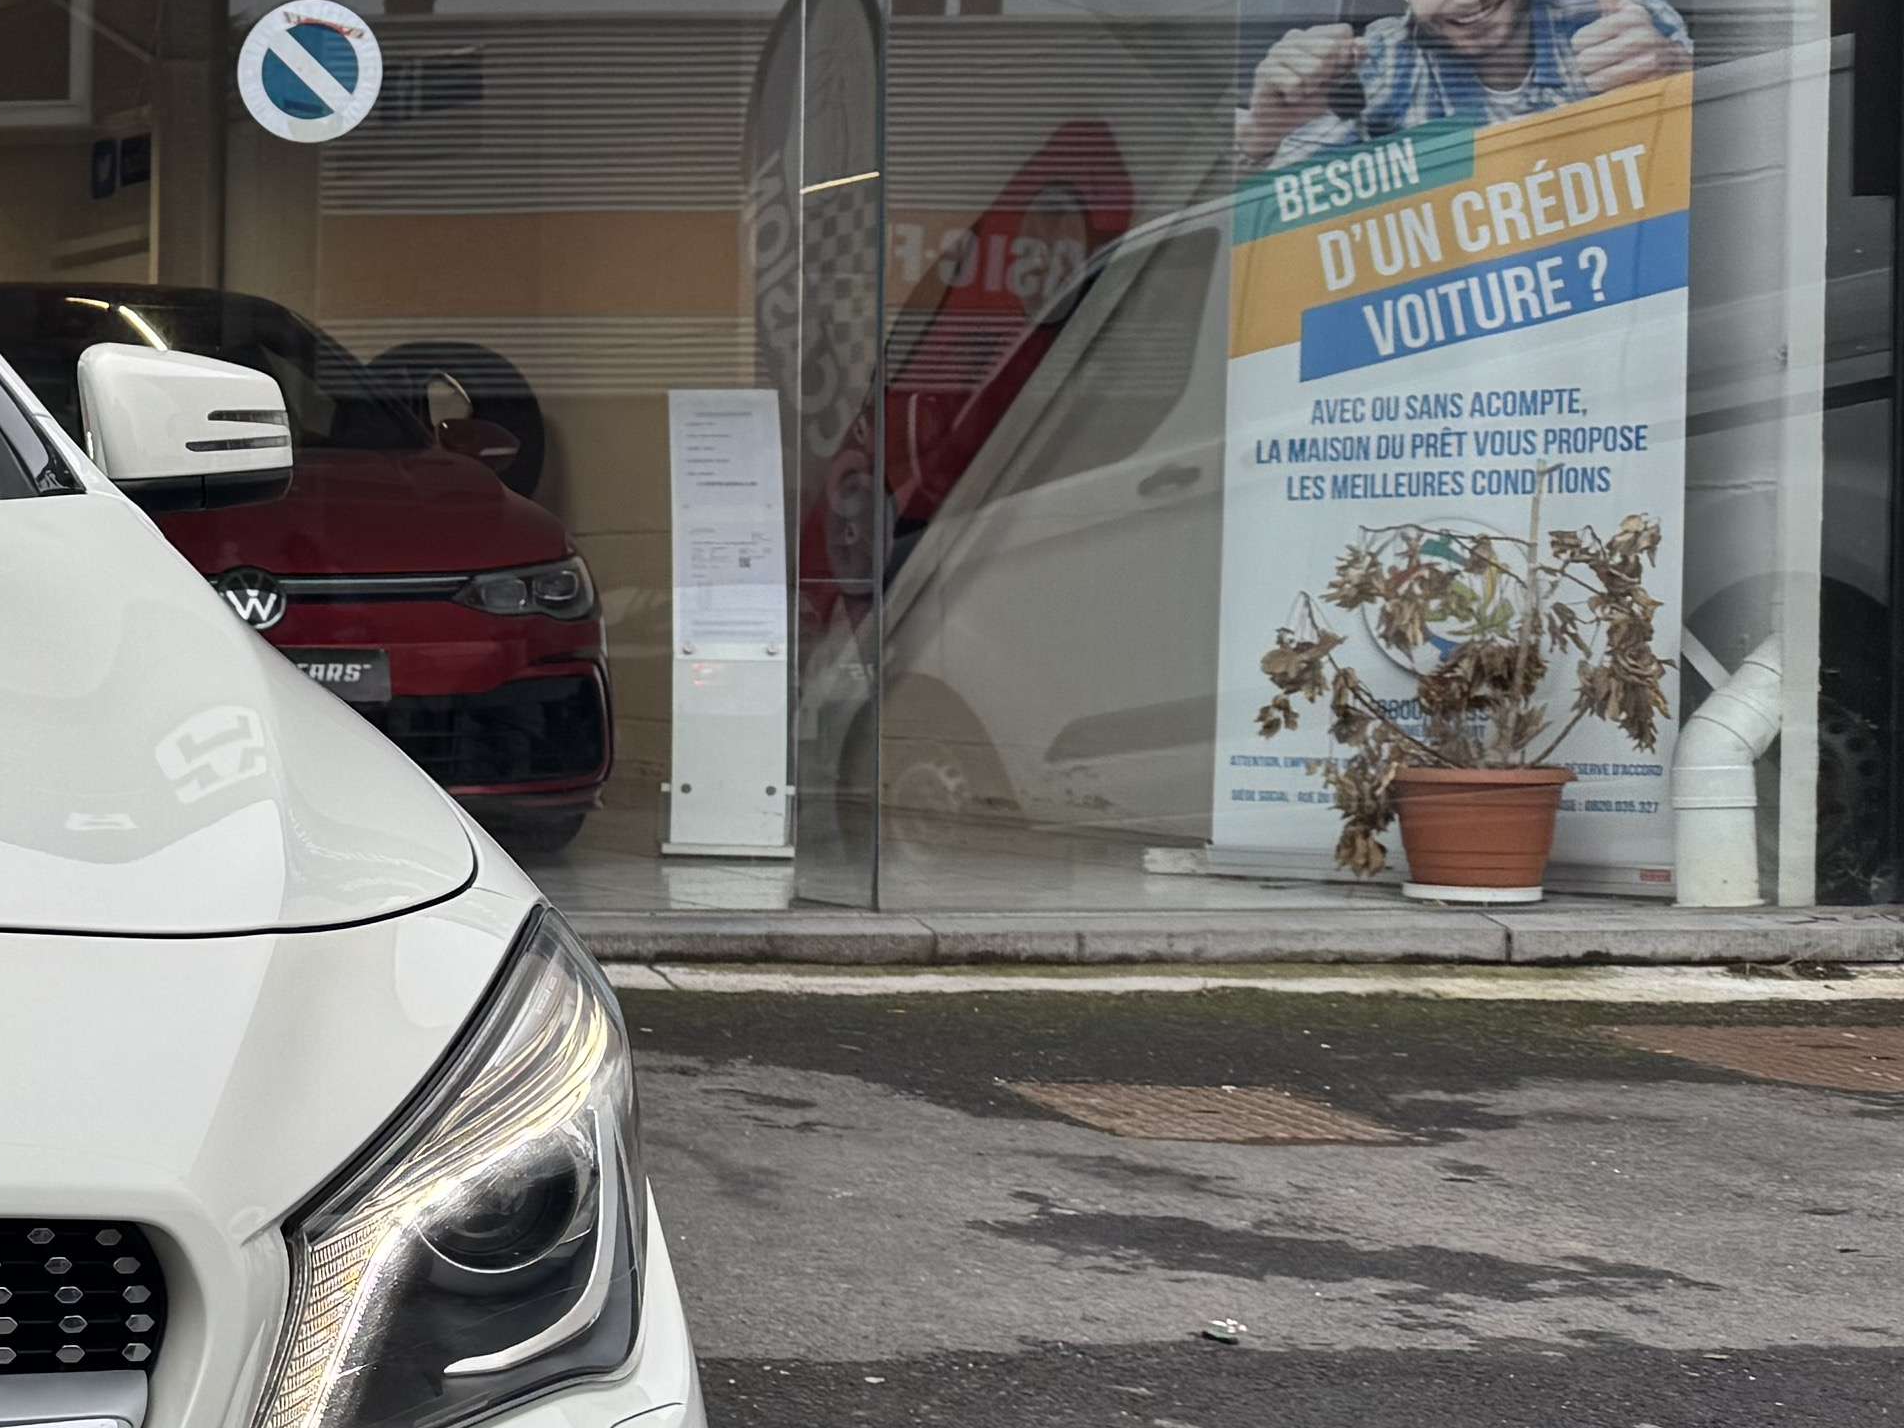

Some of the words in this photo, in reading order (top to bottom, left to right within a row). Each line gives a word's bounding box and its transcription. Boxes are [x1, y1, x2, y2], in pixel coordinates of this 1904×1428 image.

[1273, 138, 1421, 223] BESOIN
[1318, 202, 1441, 292] D'UN
[1450, 144, 1648, 253] CRÉDIT
[1362, 256, 1572, 358] VOITURE
[1577, 246, 1609, 302] ?
[1310, 397, 1365, 426] AVEC
[1371, 396, 1400, 422] OU
[1404, 393, 1463, 420] SANS
[1469, 387, 1589, 419] ACOMPTE,
[1255, 438, 1282, 465] LA
[1287, 435, 1371, 464] MAISON
[1376, 434, 1405, 460] DU
[1411, 427, 1468, 459] PRÊT
[1473, 429, 1537, 457] VOUS
[1543, 424, 1649, 455] PROPOSE
[1286, 475, 1325, 502] LES
[1330, 468, 1465, 500] MEILLEURES
[1471, 466, 1612, 496] CONDTIONS
